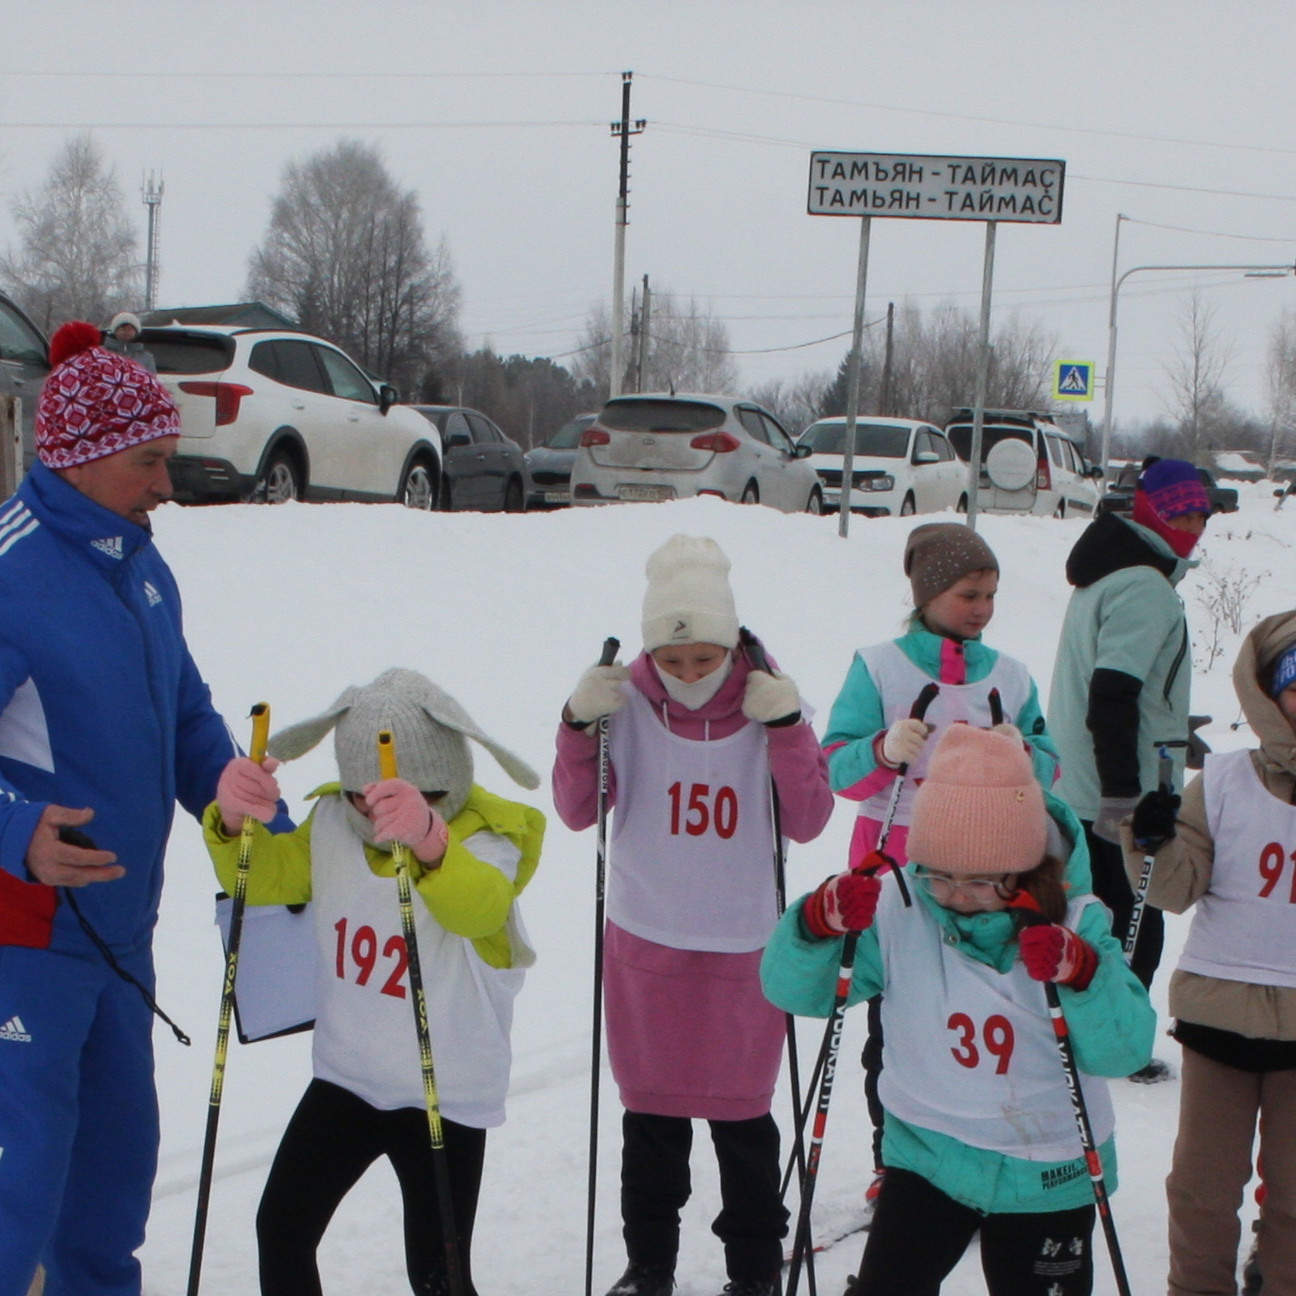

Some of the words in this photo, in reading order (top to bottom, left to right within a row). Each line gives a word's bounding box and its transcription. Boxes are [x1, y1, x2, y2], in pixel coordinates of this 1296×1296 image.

[815, 186, 920, 211] ТАМЬЯН
[944, 189, 1054, 216] ТАЙМАС
[816, 159, 923, 184] ТАМЪЯН
[667, 781, 739, 840] 150
[334, 917, 407, 999] 192
[947, 1012, 1015, 1076] 39
